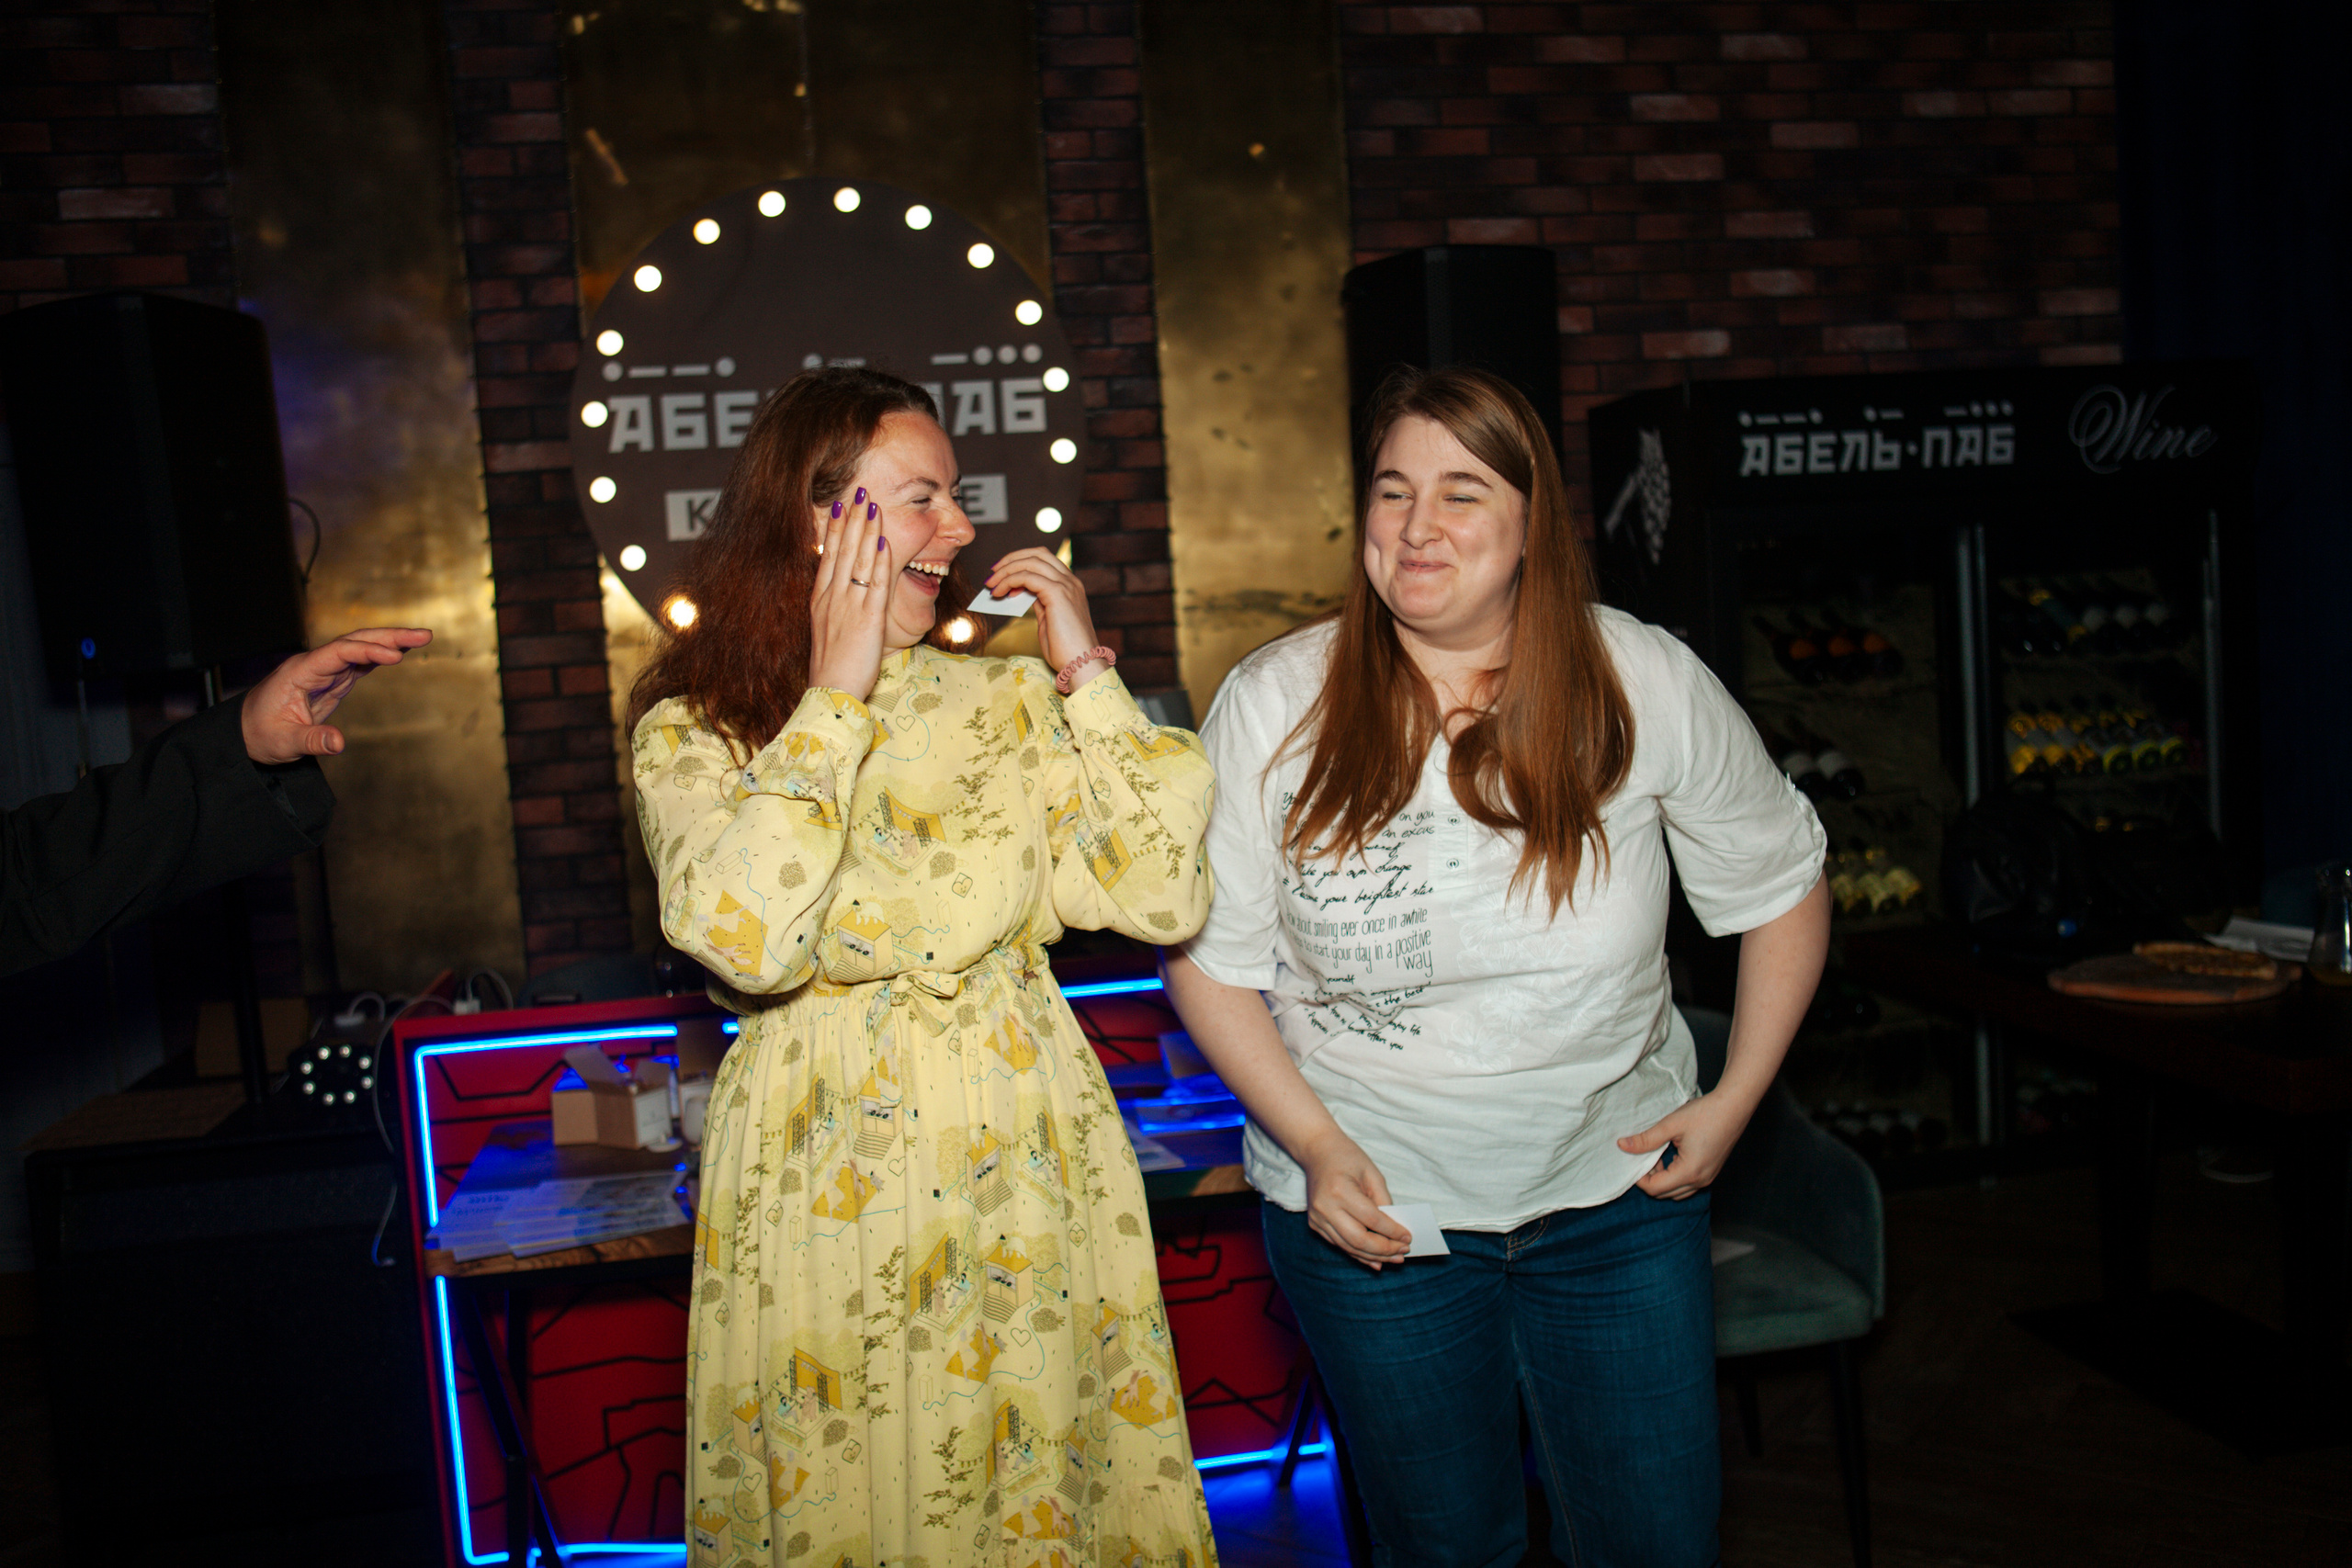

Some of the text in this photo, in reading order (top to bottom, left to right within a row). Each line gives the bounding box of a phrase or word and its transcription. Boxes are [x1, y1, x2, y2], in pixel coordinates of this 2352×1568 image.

[2068, 383, 2219, 475] Wine
[1399, 812, 1412, 822] on
[1416, 810, 1435, 826] you
[1382, 829, 1396, 839] an
[1340, 921, 1359, 937] ever
[1362, 918, 1385, 935] once
[1388, 913, 1396, 930] in
[1400, 908, 1428, 928] awhile
[1331, 946, 1352, 969] your
[1355, 942, 1373, 974] day
[1374, 940, 1384, 961] in
[1386, 942, 1393, 959] a
[1396, 929, 1431, 969] positive
[1403, 950, 1433, 978] way
